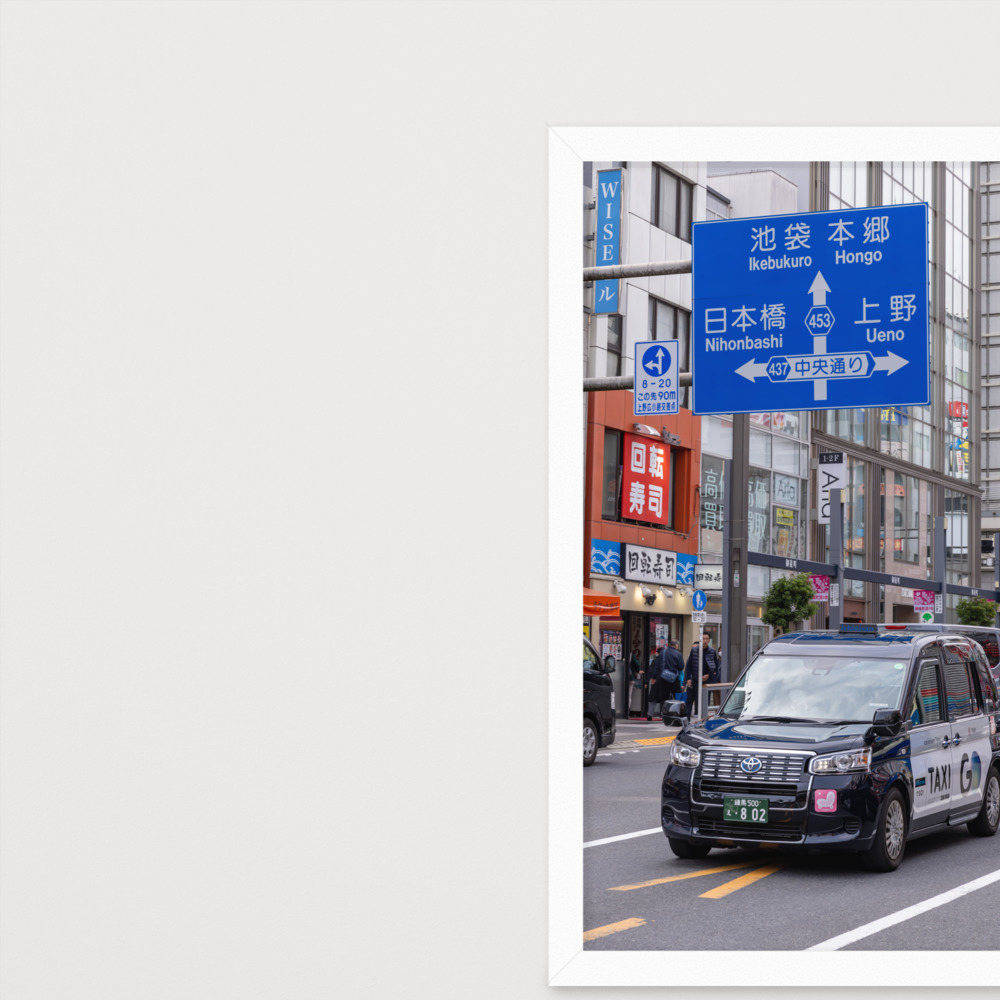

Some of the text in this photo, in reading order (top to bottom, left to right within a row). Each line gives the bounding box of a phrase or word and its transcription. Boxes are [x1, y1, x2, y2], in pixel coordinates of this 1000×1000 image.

[750, 222, 811, 252] 池袋
[827, 215, 890, 247] 本郷
[749, 254, 812, 271] Ikebukuro
[835, 249, 883, 265] Hongo
[705, 303, 786, 334] 日本橋
[854, 294, 917, 325] 上野
[808, 313, 831, 329] 453
[705, 334, 783, 352] Nihonbashi
[866, 328, 905, 343] Ueno
[768, 361, 789, 376] 437
[794, 356, 864, 377] 中央通り
[630, 441, 665, 480] 回転
[629, 481, 663, 519] 寿司
[928, 763, 951, 794] TAXI
[747, 799, 759, 807] 500
